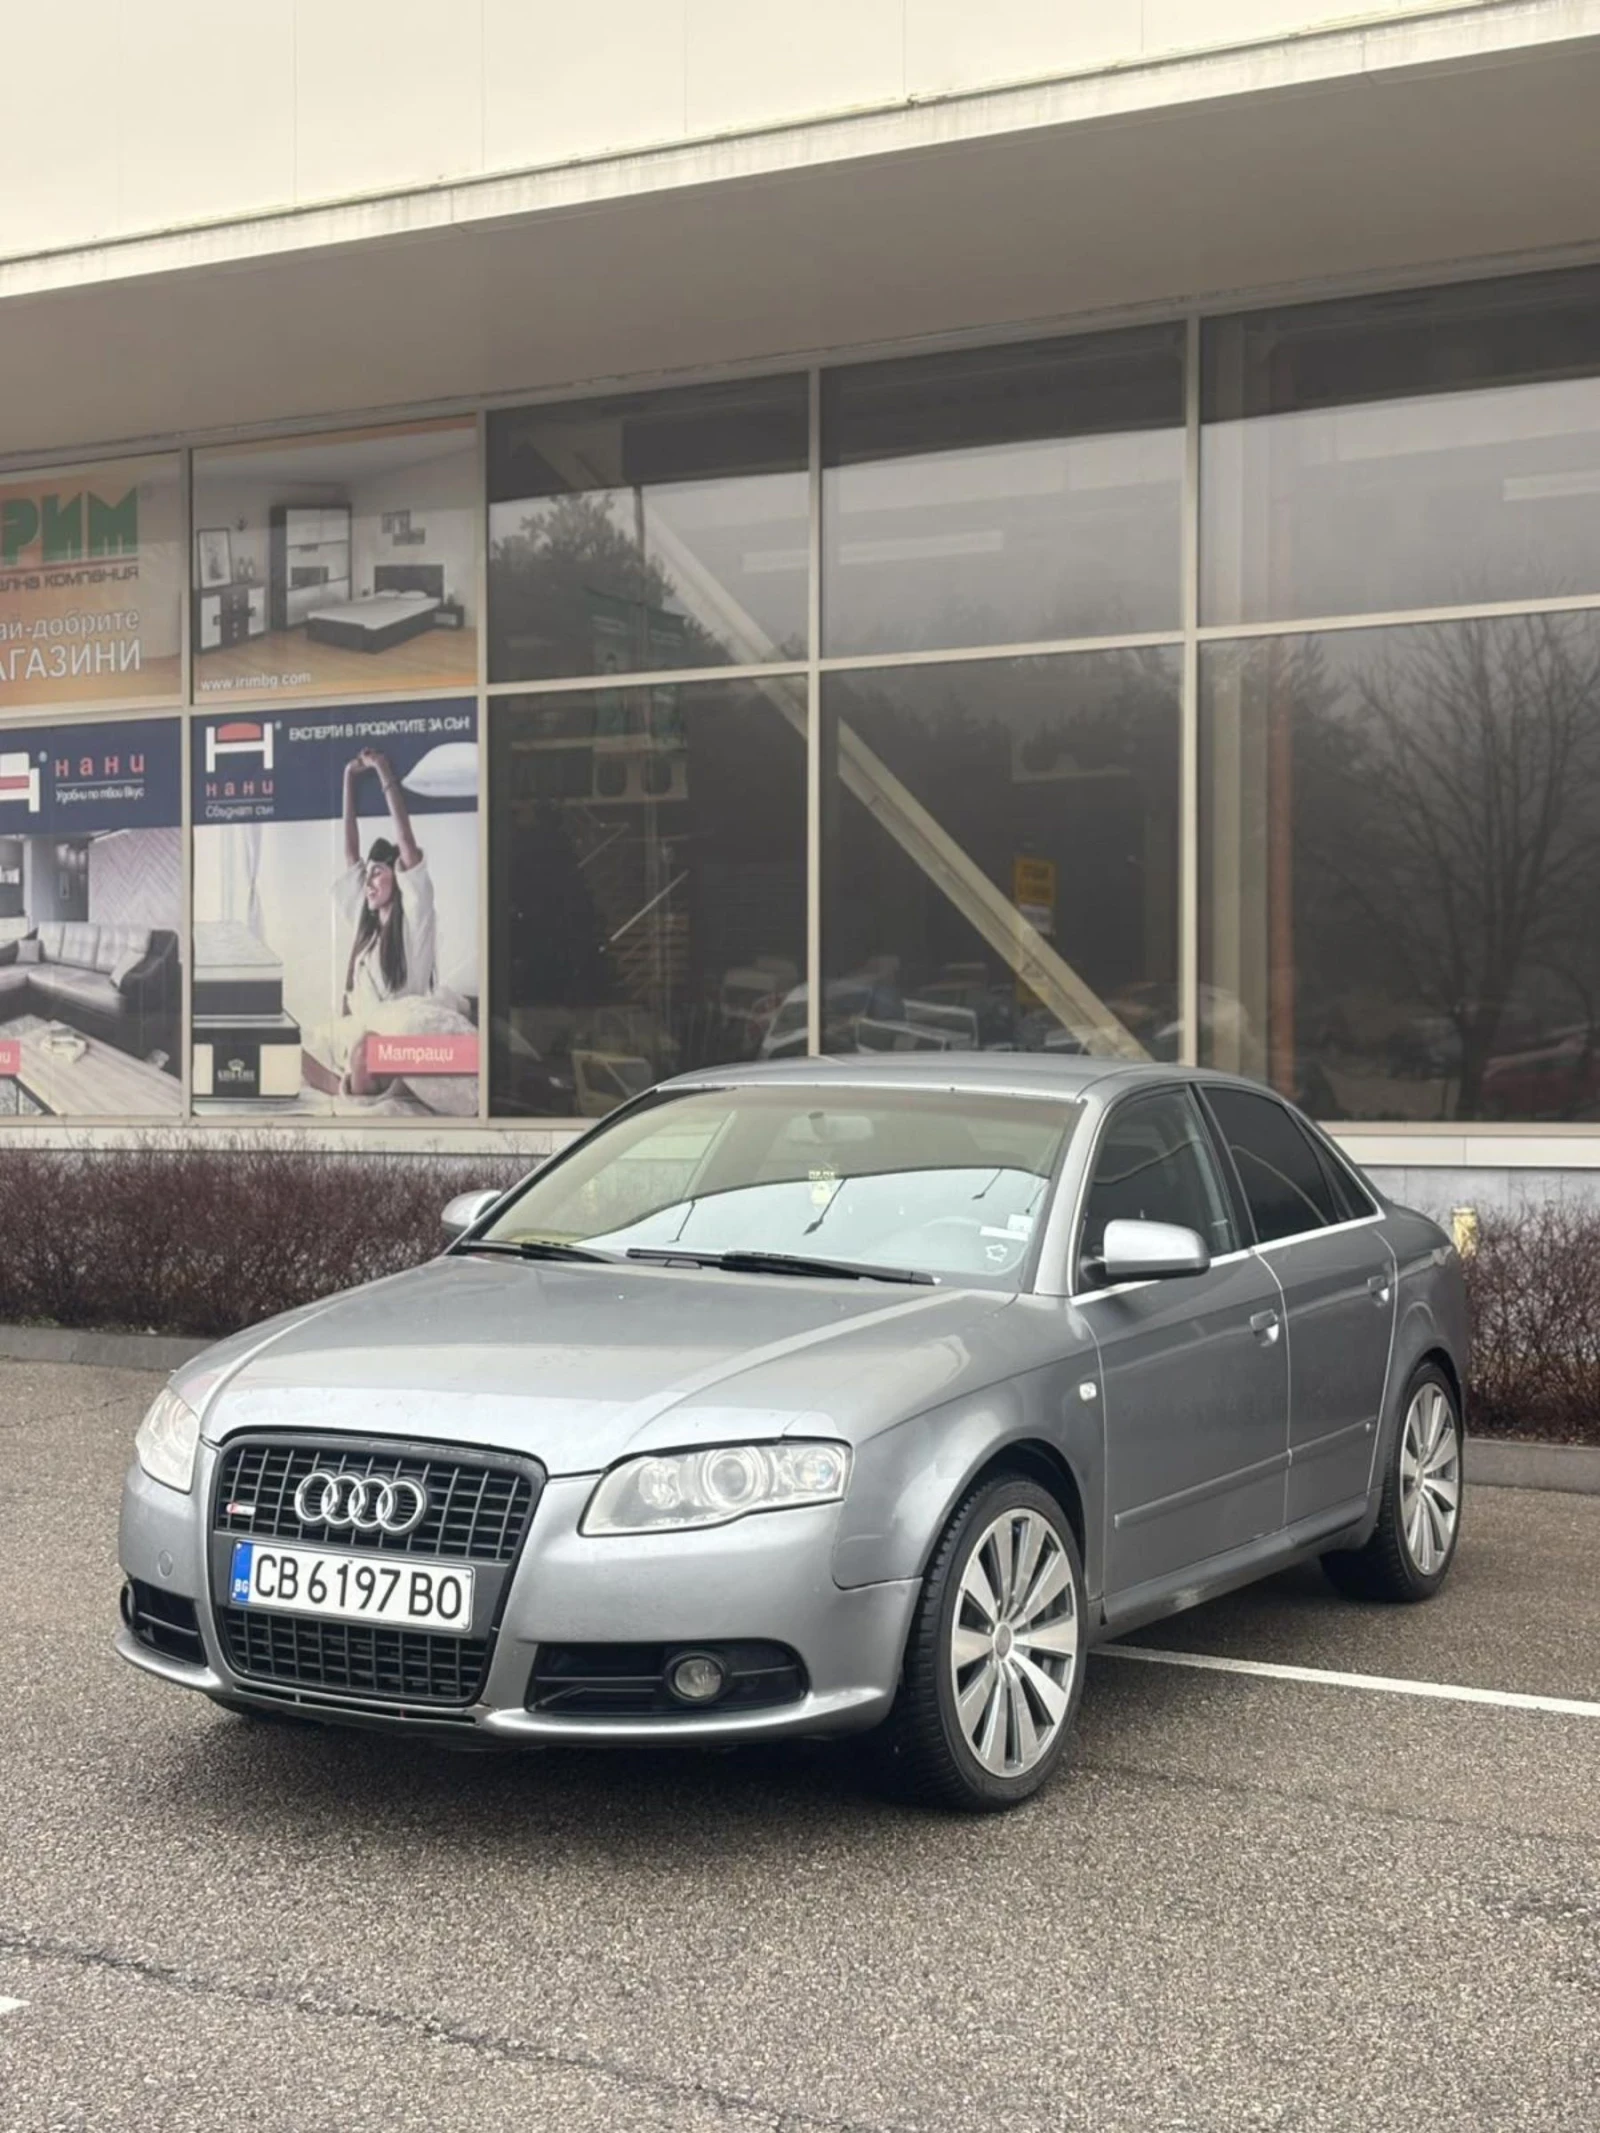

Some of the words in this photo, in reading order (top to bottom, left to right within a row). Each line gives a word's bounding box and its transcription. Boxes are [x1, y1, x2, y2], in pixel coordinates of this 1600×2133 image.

[200, 672, 311, 690] www.irimbg.com
[377, 1044, 454, 1064] Матраци
[234, 1577, 249, 1594] BG
